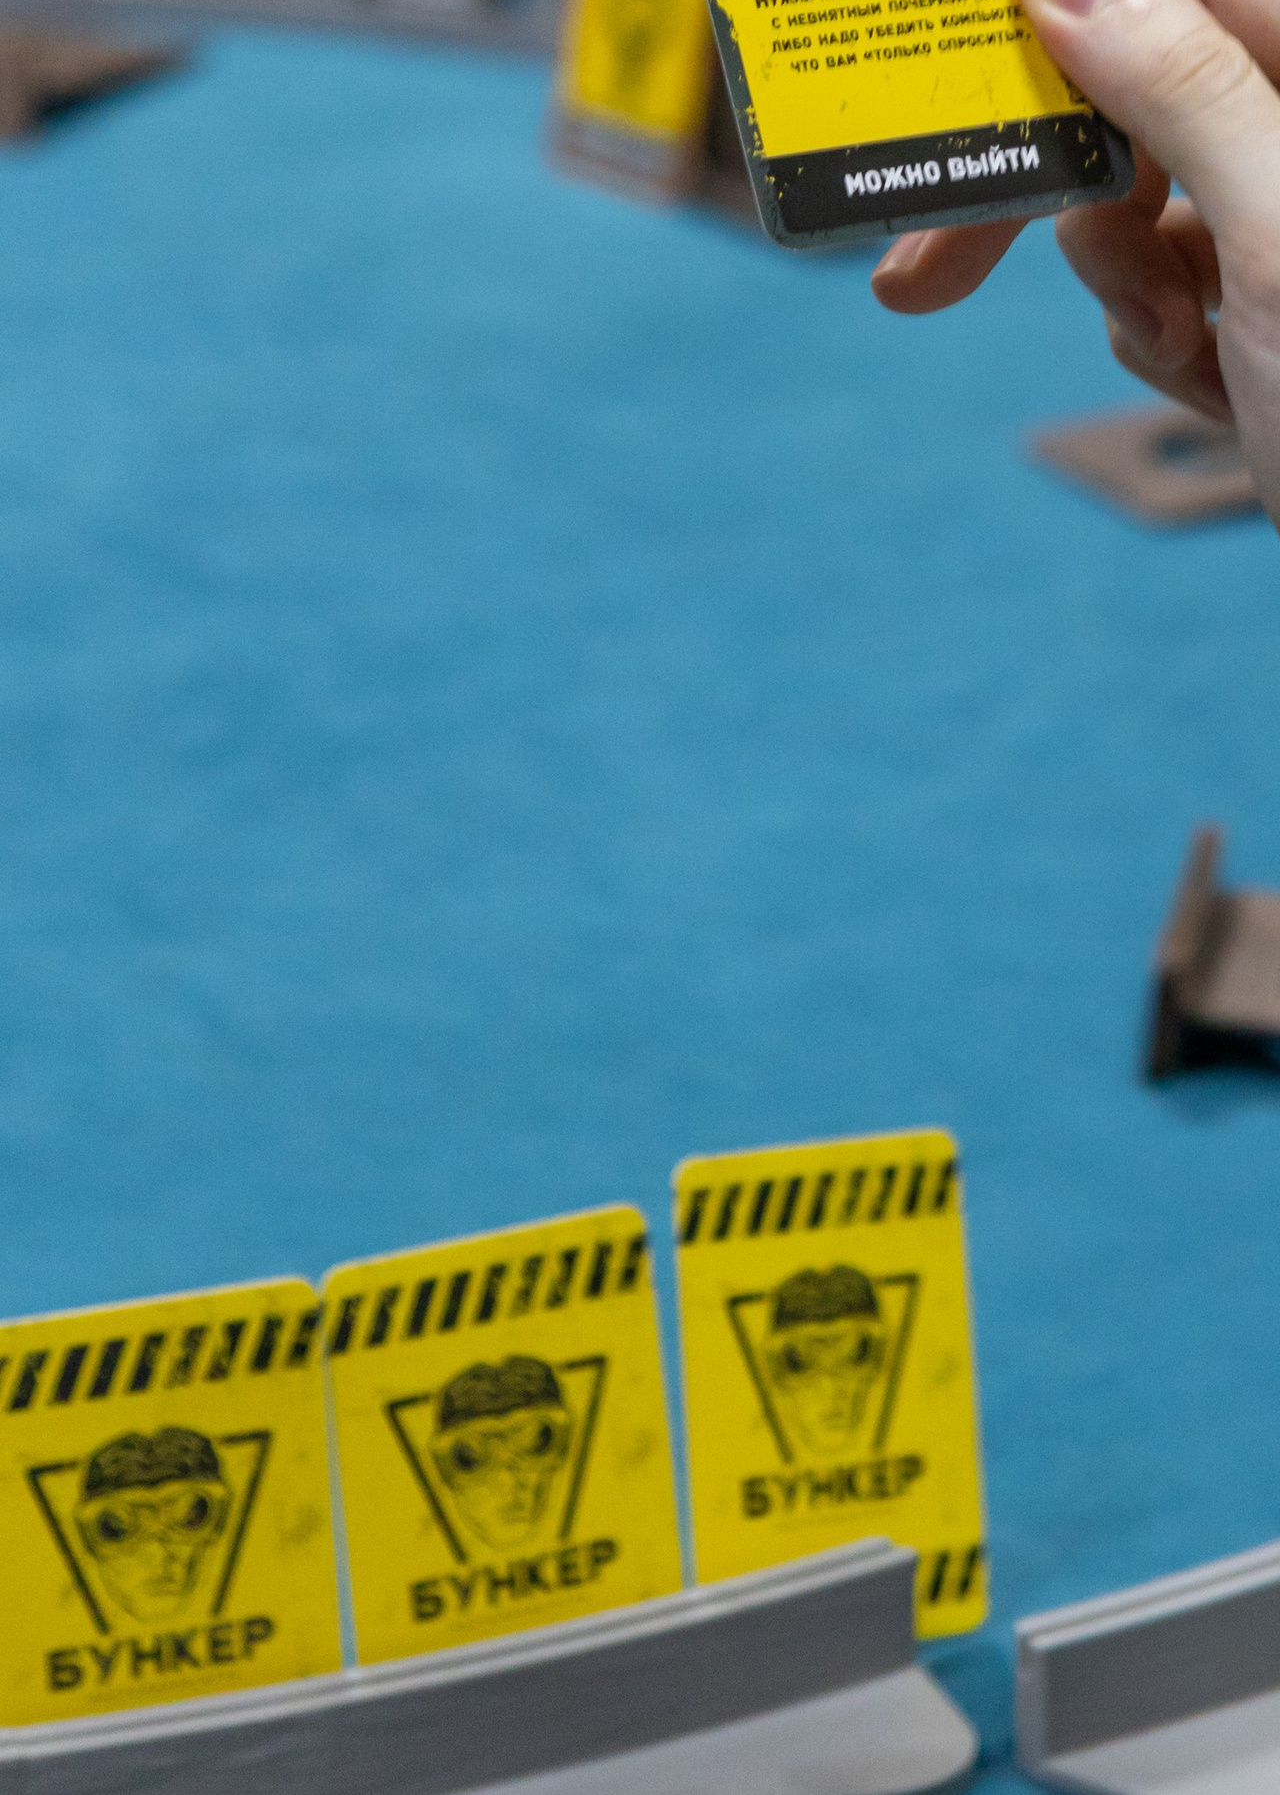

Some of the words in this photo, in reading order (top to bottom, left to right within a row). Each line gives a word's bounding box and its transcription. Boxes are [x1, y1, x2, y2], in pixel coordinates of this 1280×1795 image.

[772, 17, 781, 29] С
[787, 2, 882, 27] НЕВНЯТНЫМ
[772, 36, 812, 53] ЛИБО
[818, 29, 859, 46] НАДО
[865, 18, 934, 39] УБЕДИТЬ
[790, 58, 819, 73] ЧТО
[825, 52, 857, 68] ВАМ
[844, 159, 940, 197] МОЖНО
[948, 144, 1039, 182] ВЫЙТИ
[734, 1453, 924, 1519] БУНКЕР
[409, 1536, 620, 1623] БУНКЕР
[46, 1615, 278, 1692] БУНКЕР
